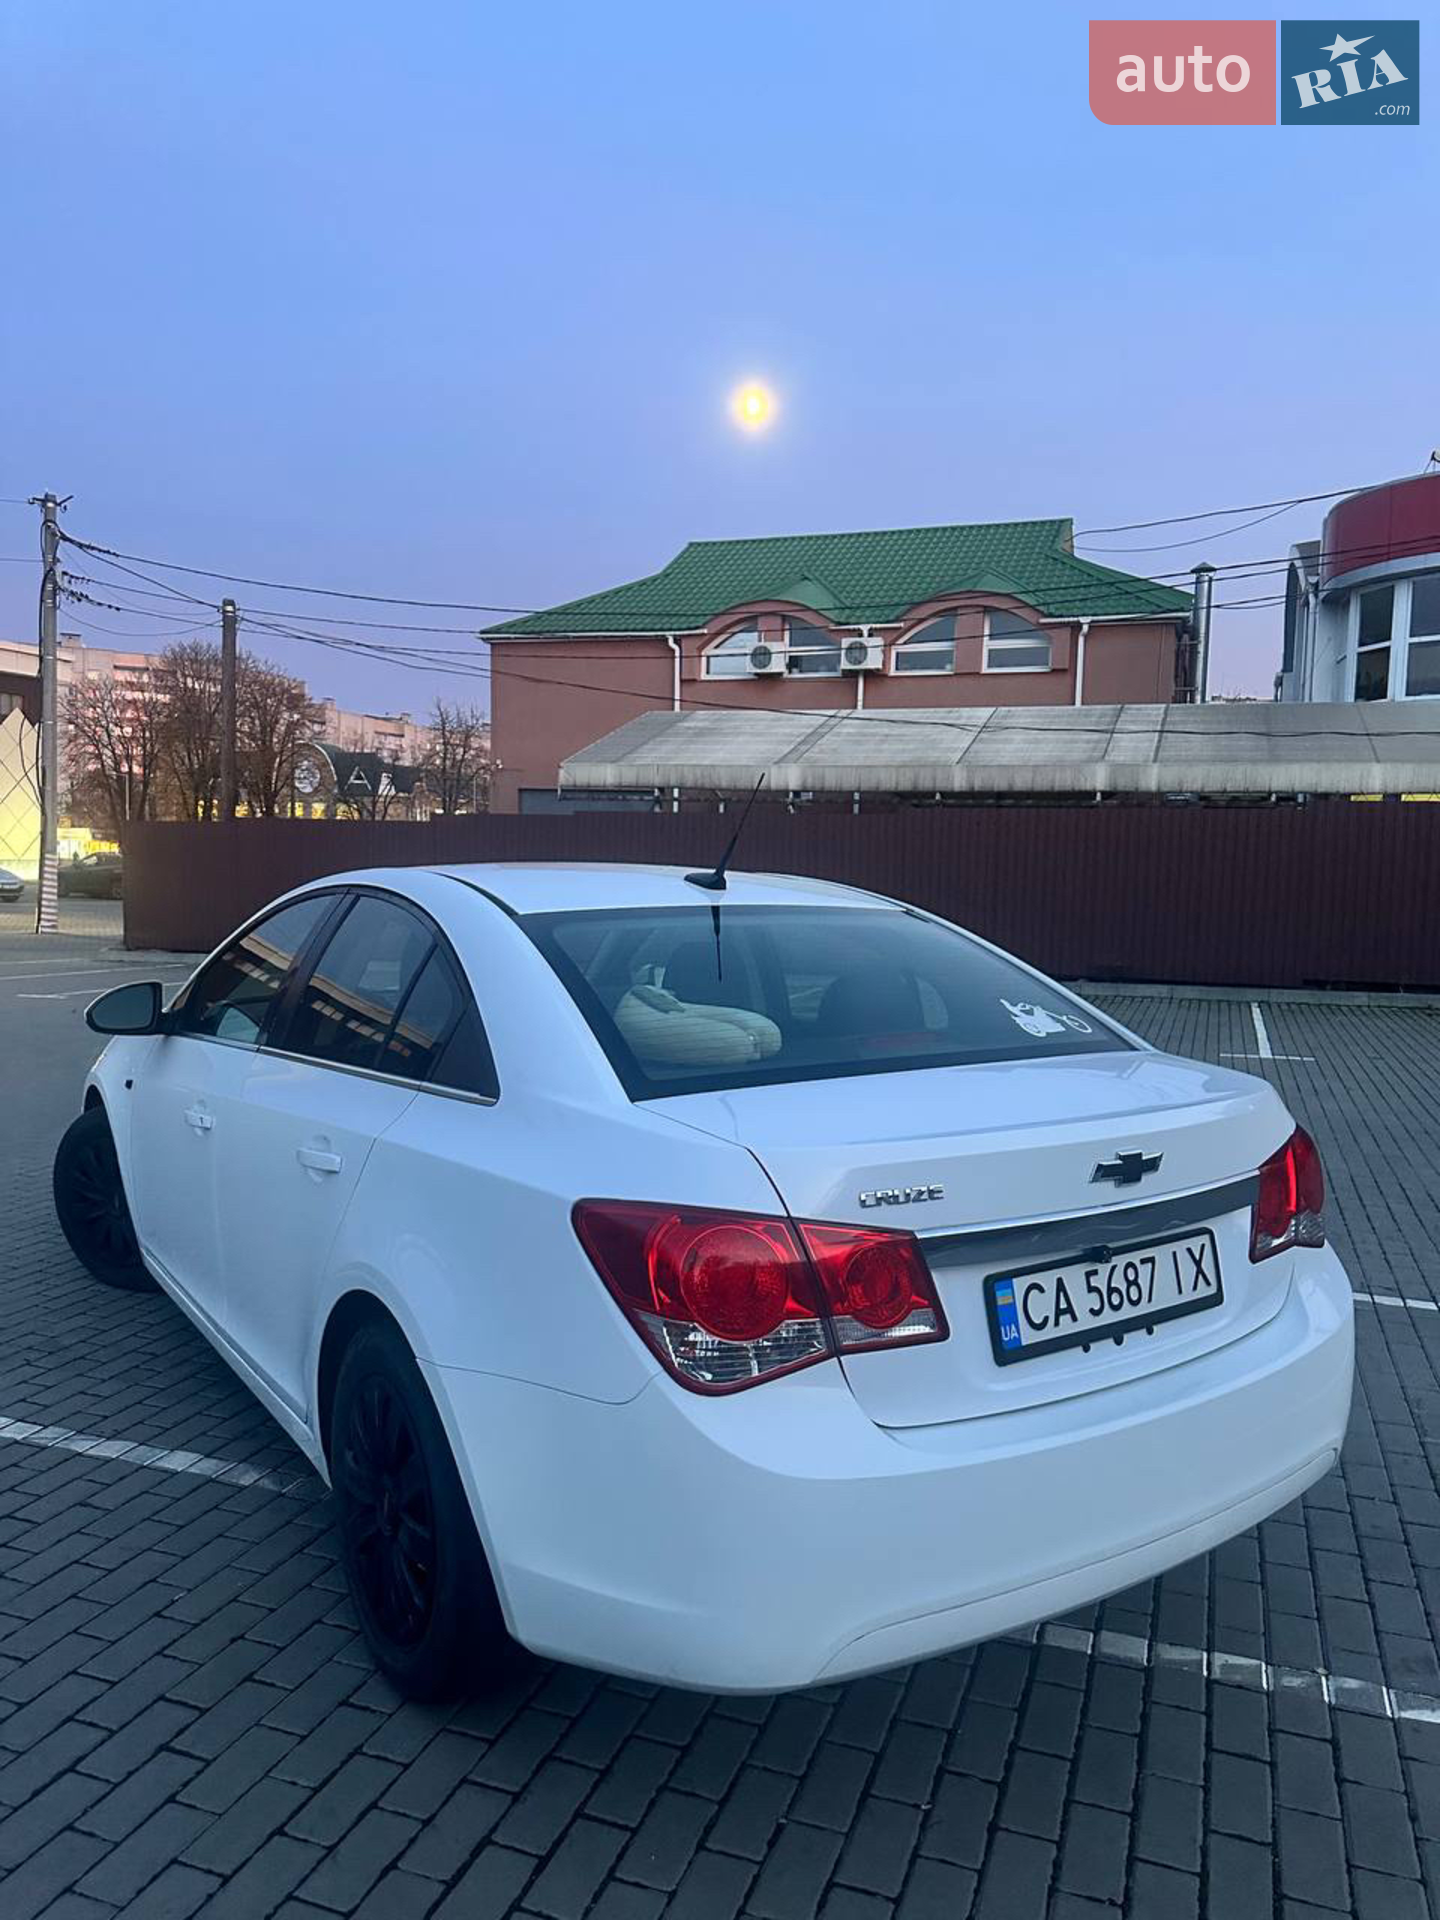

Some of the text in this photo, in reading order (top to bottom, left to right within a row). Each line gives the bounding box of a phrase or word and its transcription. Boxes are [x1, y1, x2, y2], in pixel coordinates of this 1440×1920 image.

[859, 1184, 944, 1209] CRUZE
[1022, 1243, 1211, 1331] CA 5687 IX
[1001, 1325, 1019, 1341] UA
